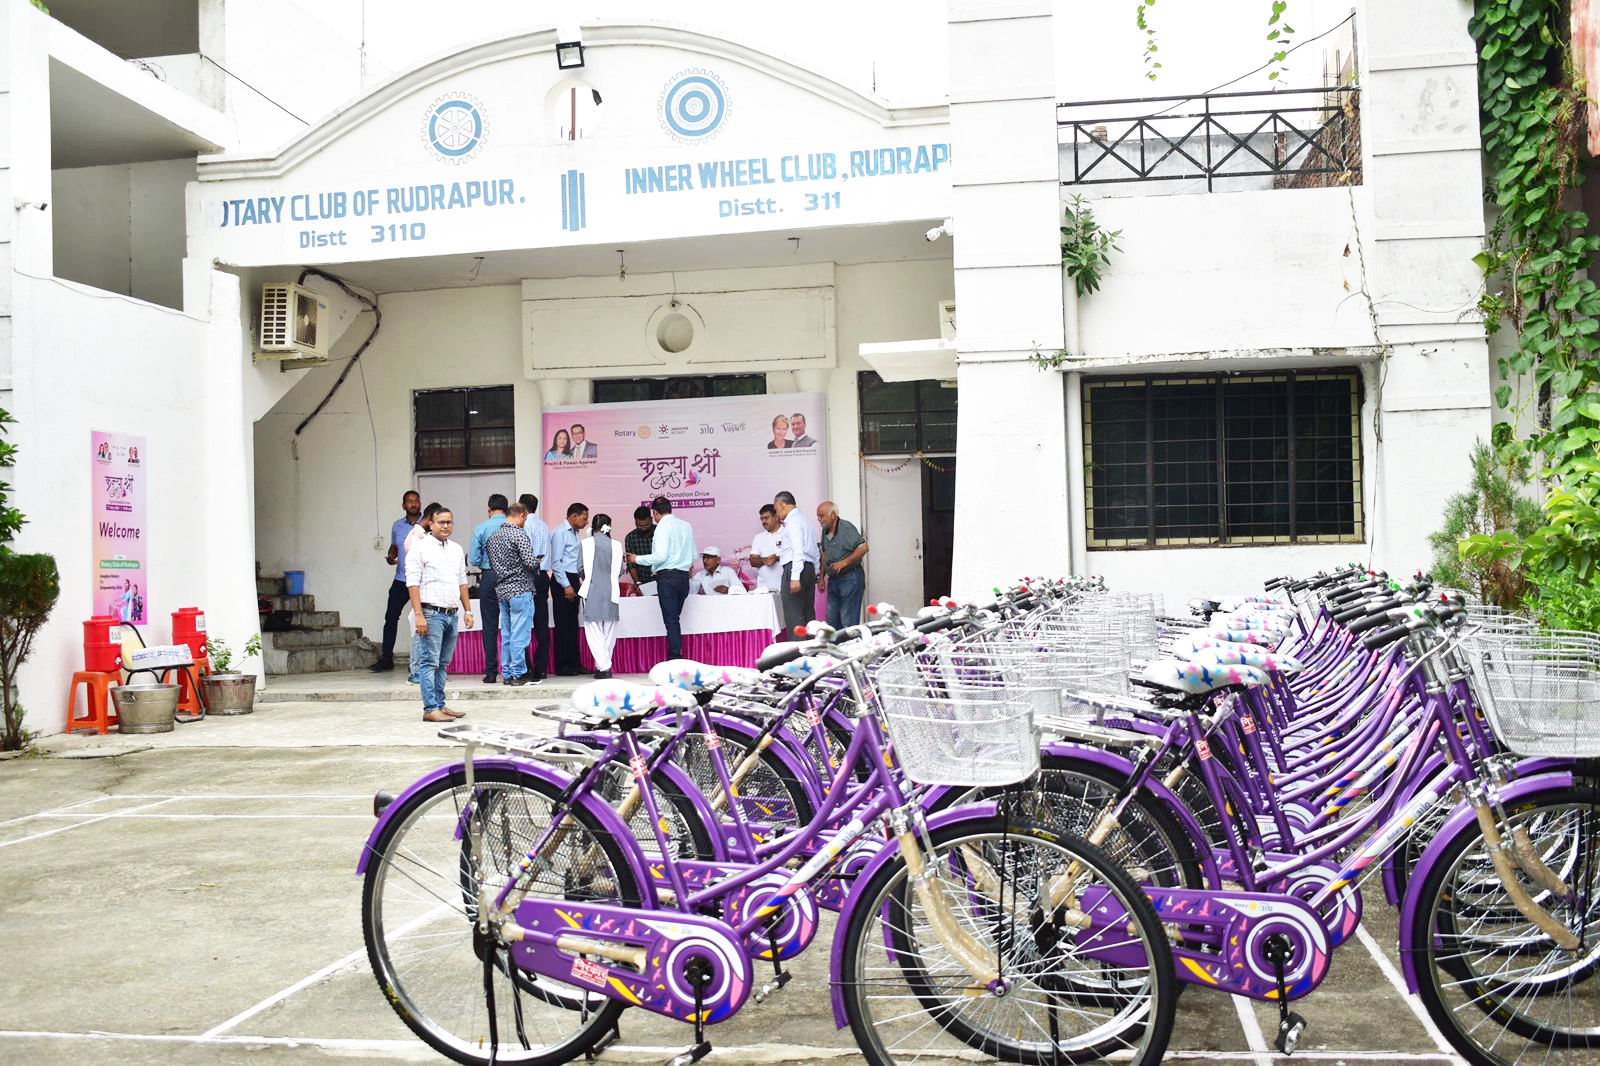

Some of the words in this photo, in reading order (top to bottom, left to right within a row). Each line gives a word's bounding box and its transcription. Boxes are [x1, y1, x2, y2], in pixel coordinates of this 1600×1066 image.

[625, 164, 693, 194] INNER
[697, 158, 776, 189] WHEEL
[290, 192, 347, 222] CLUB
[353, 189, 380, 217] OF
[804, 190, 842, 211] 311
[299, 229, 347, 249] Distt
[370, 222, 426, 243] 3110
[614, 429, 637, 438] Rotary
[637, 456, 689, 482] कन्या
[691, 448, 721, 477] श्री
[666, 490, 694, 498] Donation
[694, 489, 710, 497] Drive
[99, 522, 141, 539] Welcome
[664, 840, 680, 865] 3110
